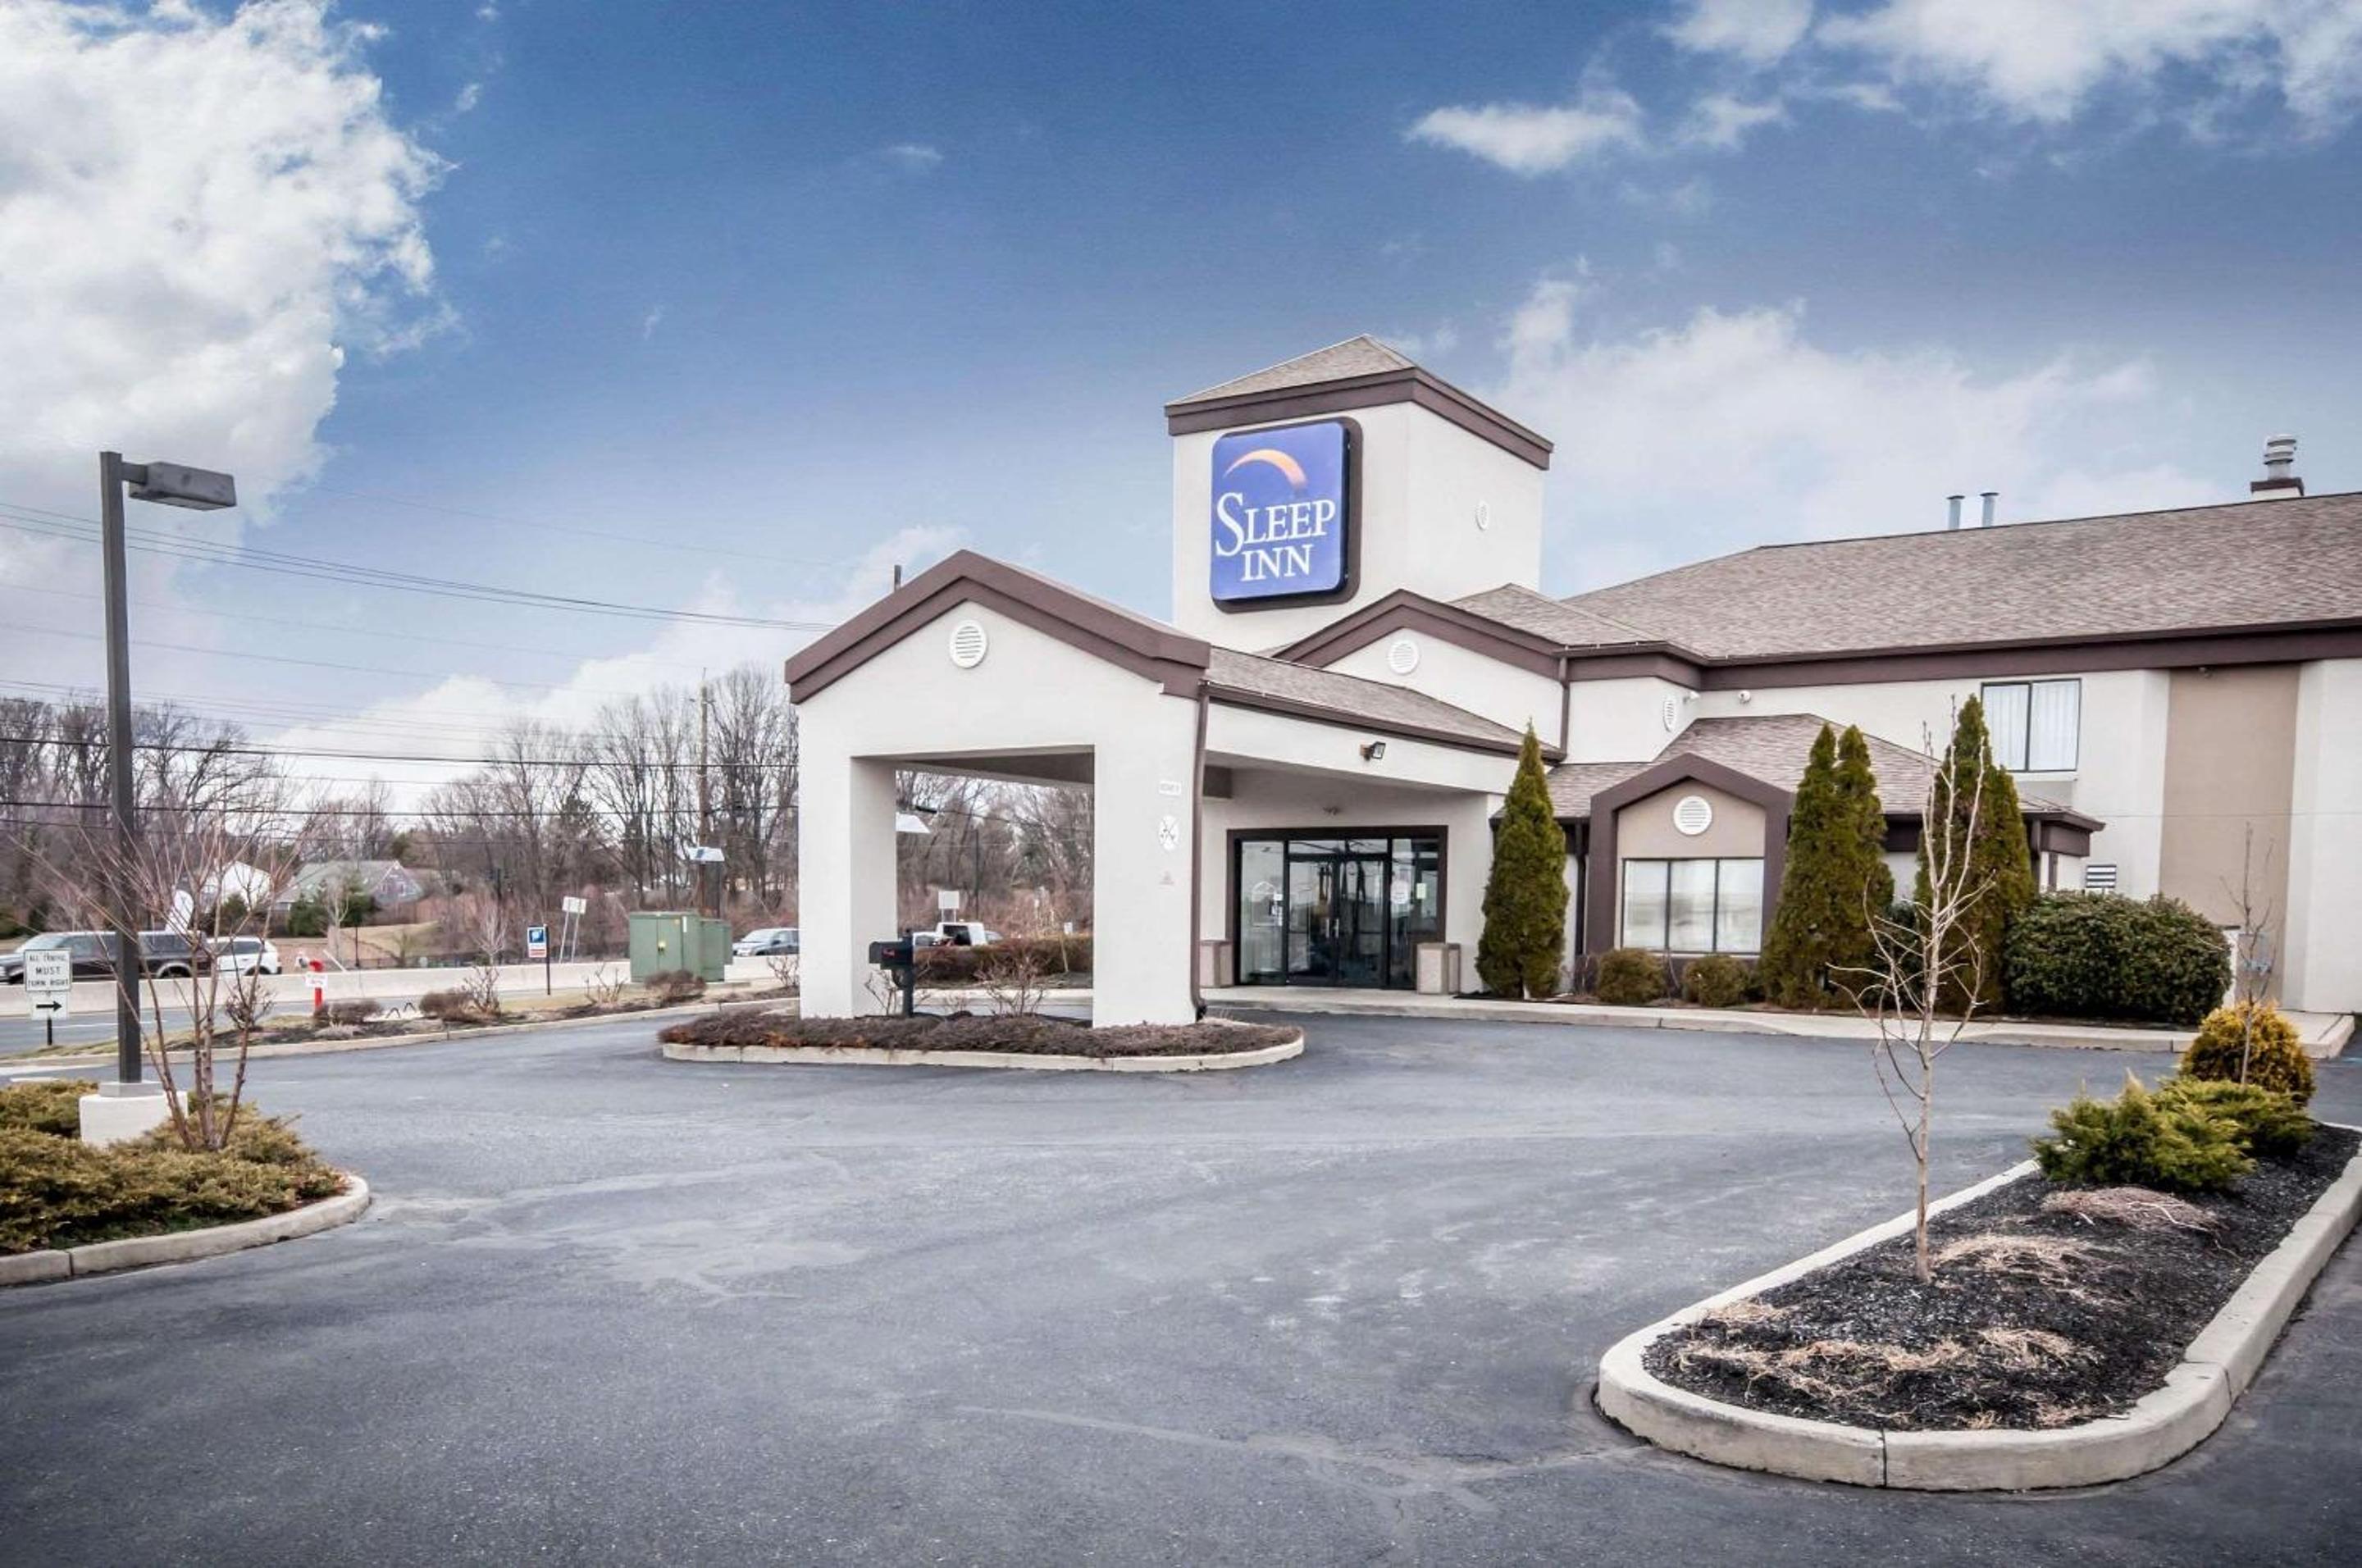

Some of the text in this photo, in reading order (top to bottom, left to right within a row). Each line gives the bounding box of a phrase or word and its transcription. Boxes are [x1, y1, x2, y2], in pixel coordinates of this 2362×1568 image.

[1215, 492, 1336, 556] SLEEP
[1241, 544, 1313, 581] INN
[35, 966, 61, 975] MUST
